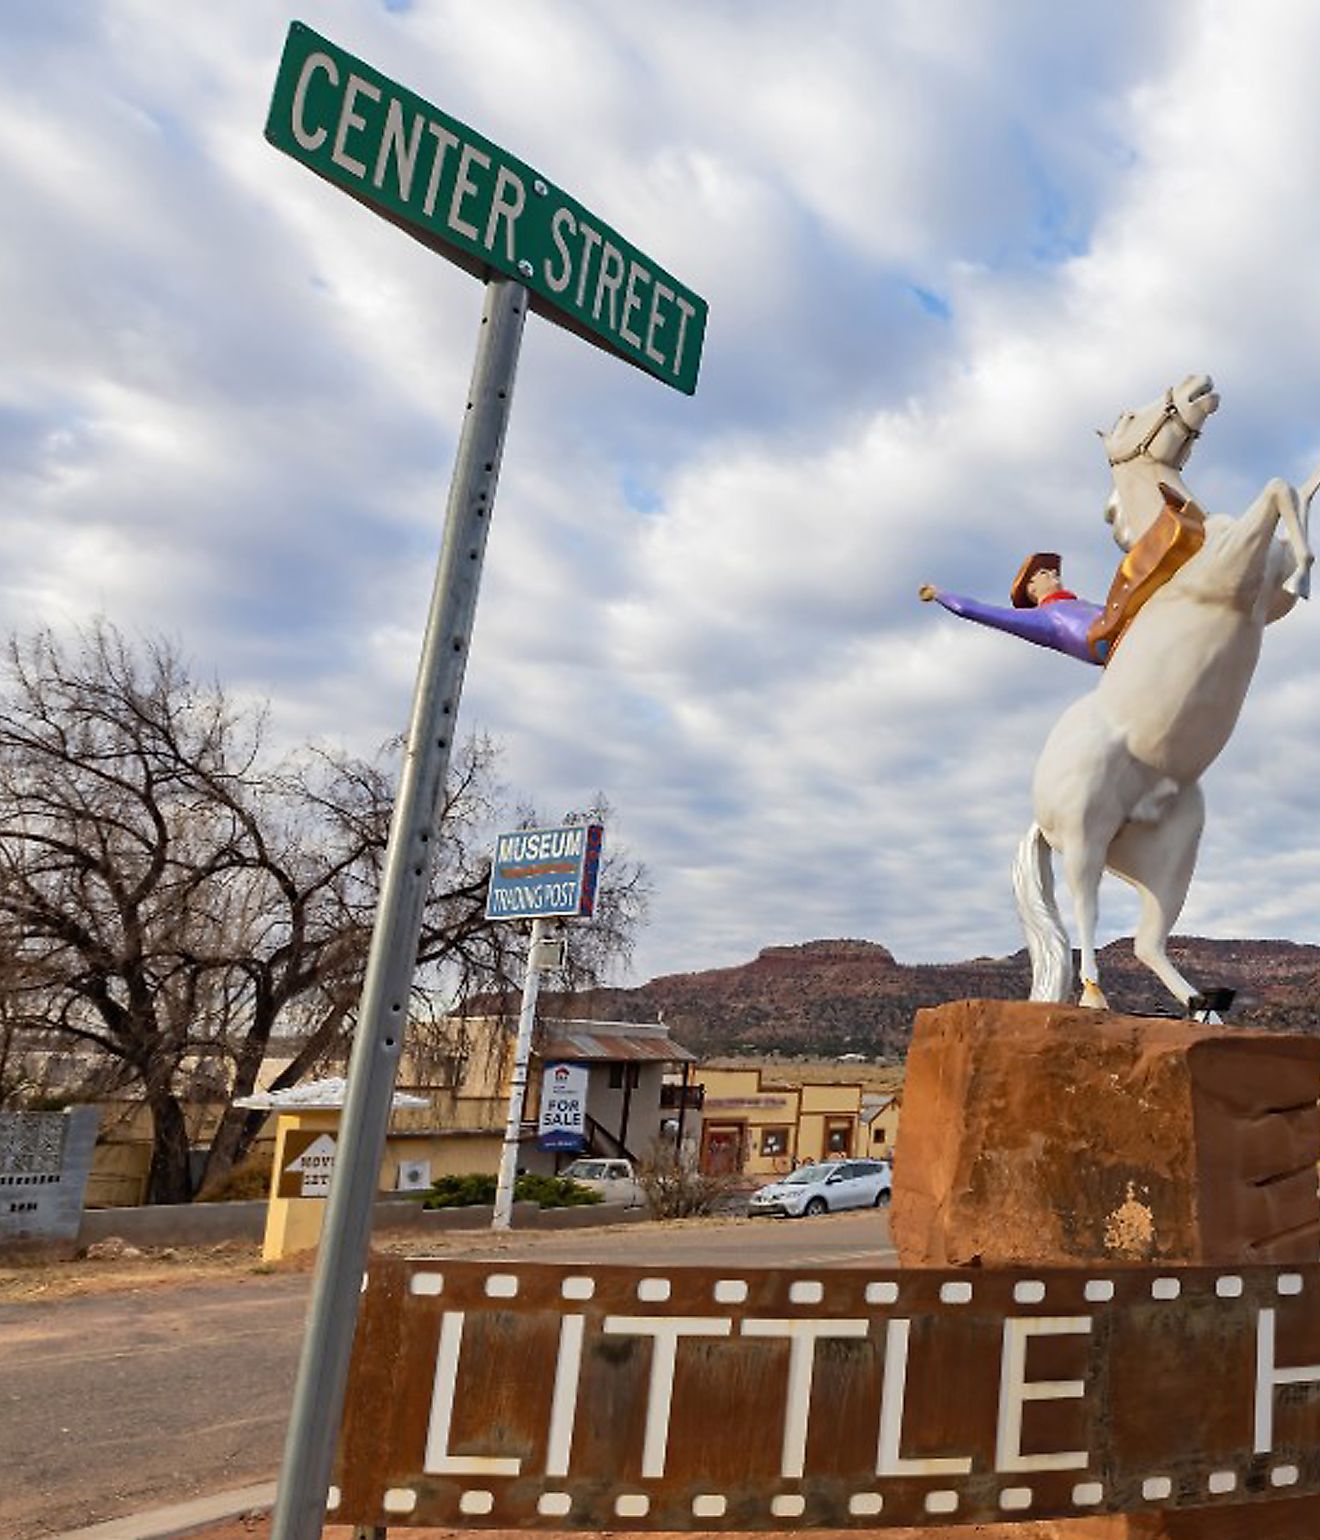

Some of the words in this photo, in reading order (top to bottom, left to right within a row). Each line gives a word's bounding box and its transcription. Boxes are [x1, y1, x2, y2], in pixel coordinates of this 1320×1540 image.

[290, 51, 526, 262] CENTER
[544, 207, 696, 377] STREET
[498, 832, 581, 862] MUSEUM
[493, 884, 543, 912] TRADING
[543, 882, 577, 908] POST
[543, 1113, 581, 1126] SALE
[548, 1099, 579, 1112] FOR
[423, 1311, 1092, 1479] LITTLE
